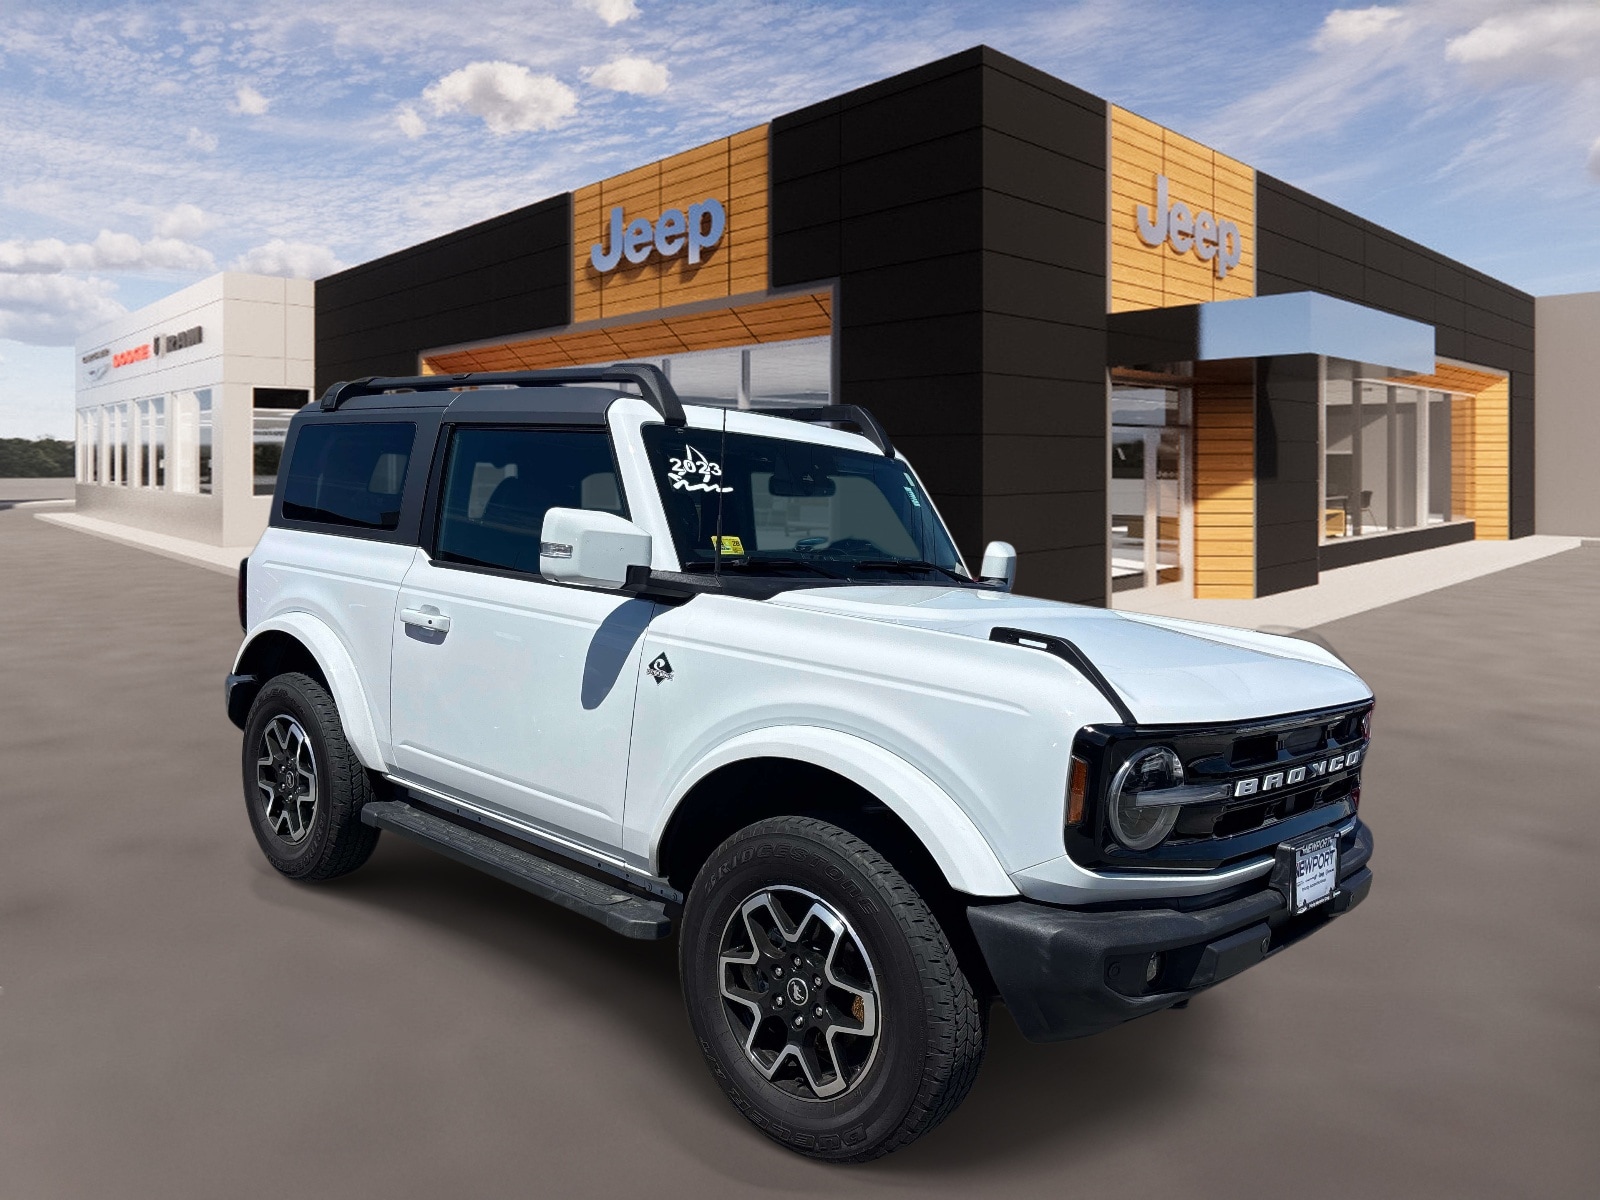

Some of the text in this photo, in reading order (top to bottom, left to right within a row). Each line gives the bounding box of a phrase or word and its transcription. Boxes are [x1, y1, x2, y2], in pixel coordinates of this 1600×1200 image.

[590, 198, 726, 272] Jeep
[1136, 173, 1242, 279] Jeep
[166, 326, 203, 353] RAM
[669, 458, 722, 476] 2023
[1234, 750, 1360, 797] BRONCO
